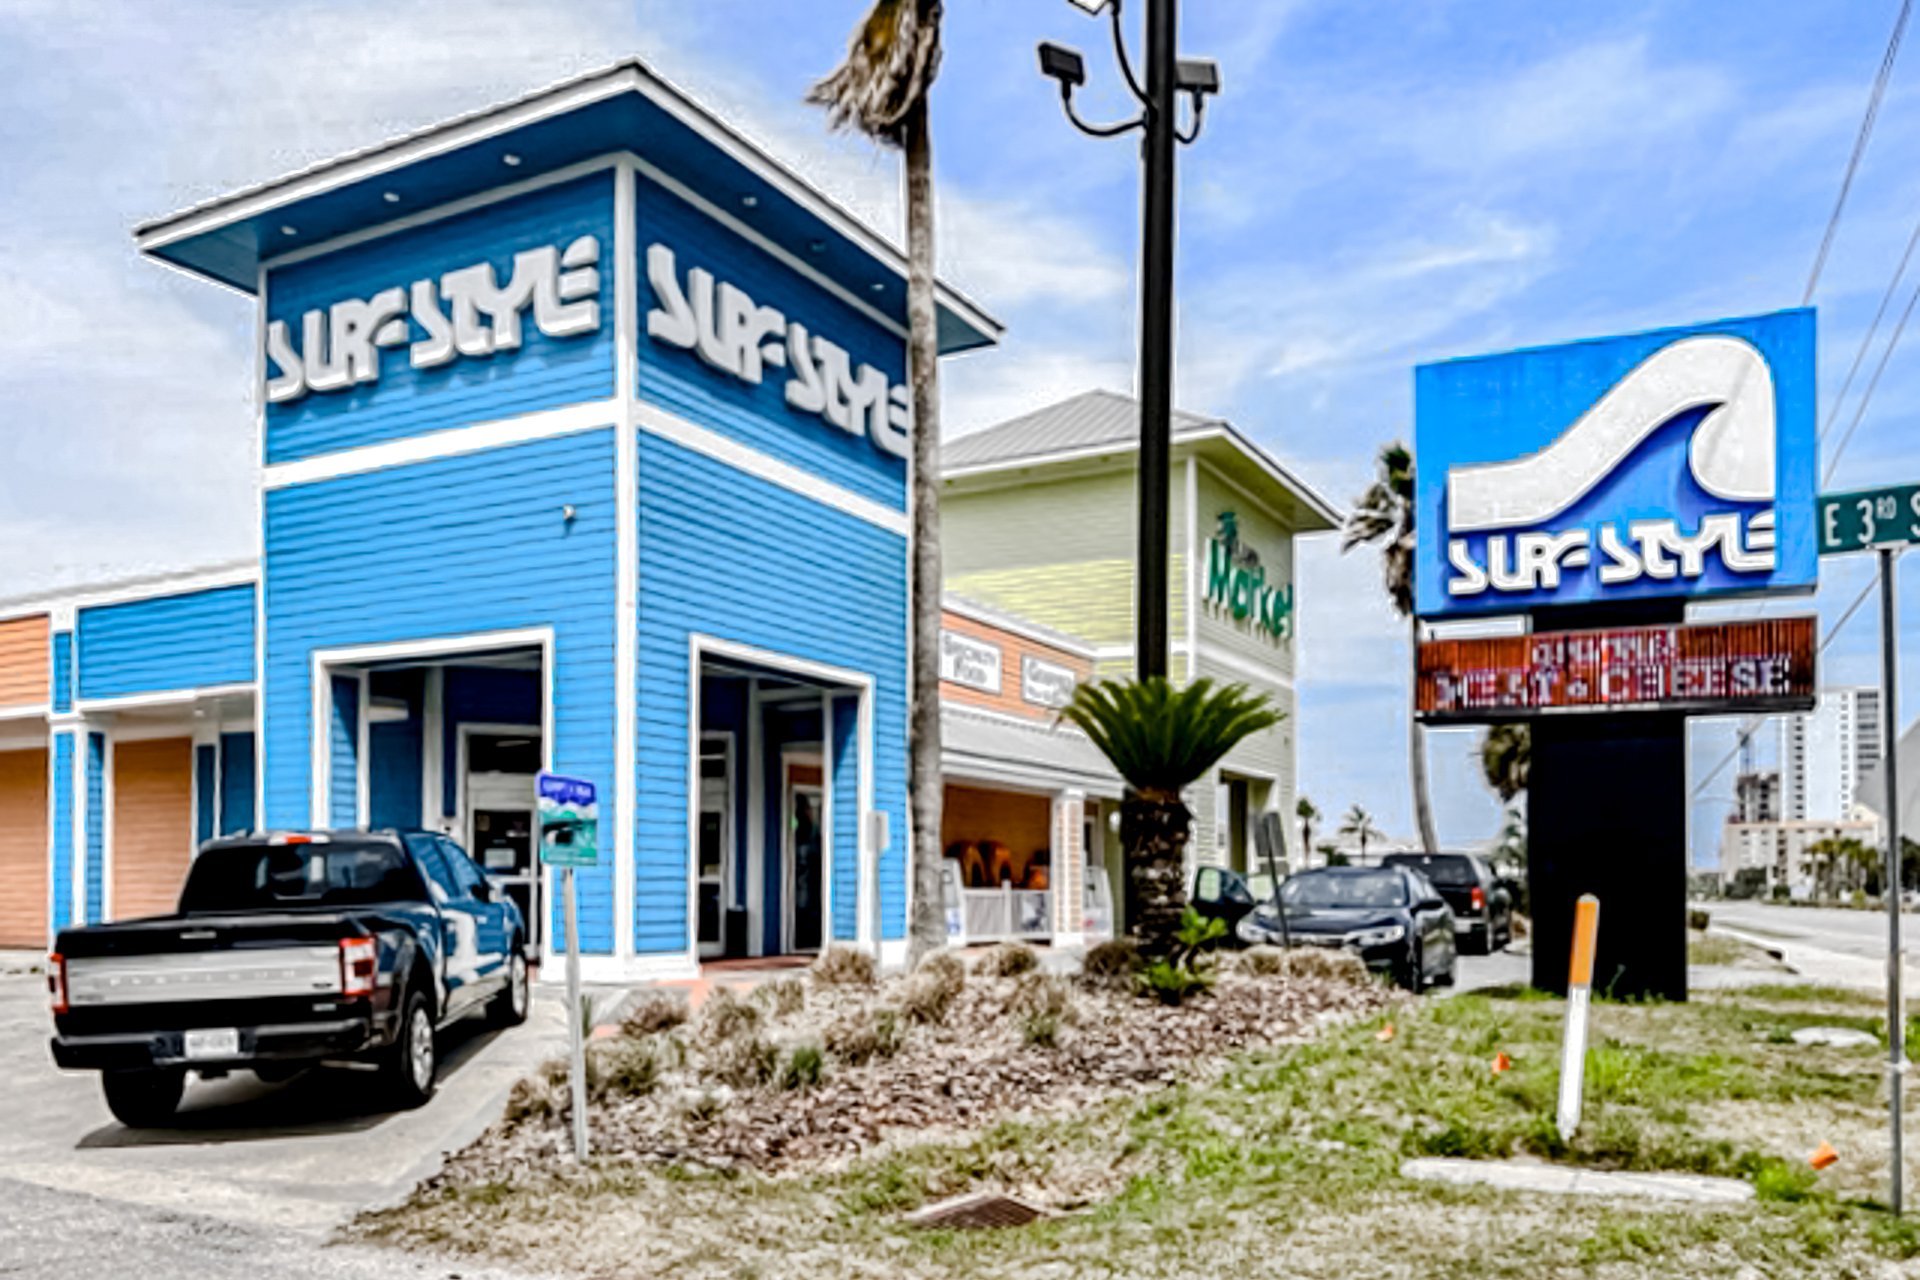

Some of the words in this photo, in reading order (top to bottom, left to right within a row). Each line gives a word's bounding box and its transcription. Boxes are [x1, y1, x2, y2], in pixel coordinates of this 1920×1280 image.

[267, 288, 408, 402] SURF
[410, 236, 599, 369] STYLE
[647, 243, 786, 384] SURF
[785, 323, 909, 461] STYLE
[1449, 528, 1590, 595] SURF
[1600, 509, 1776, 584] STYLE
[1824, 503, 1842, 546] E
[1601, 653, 1792, 701] CHEESE
